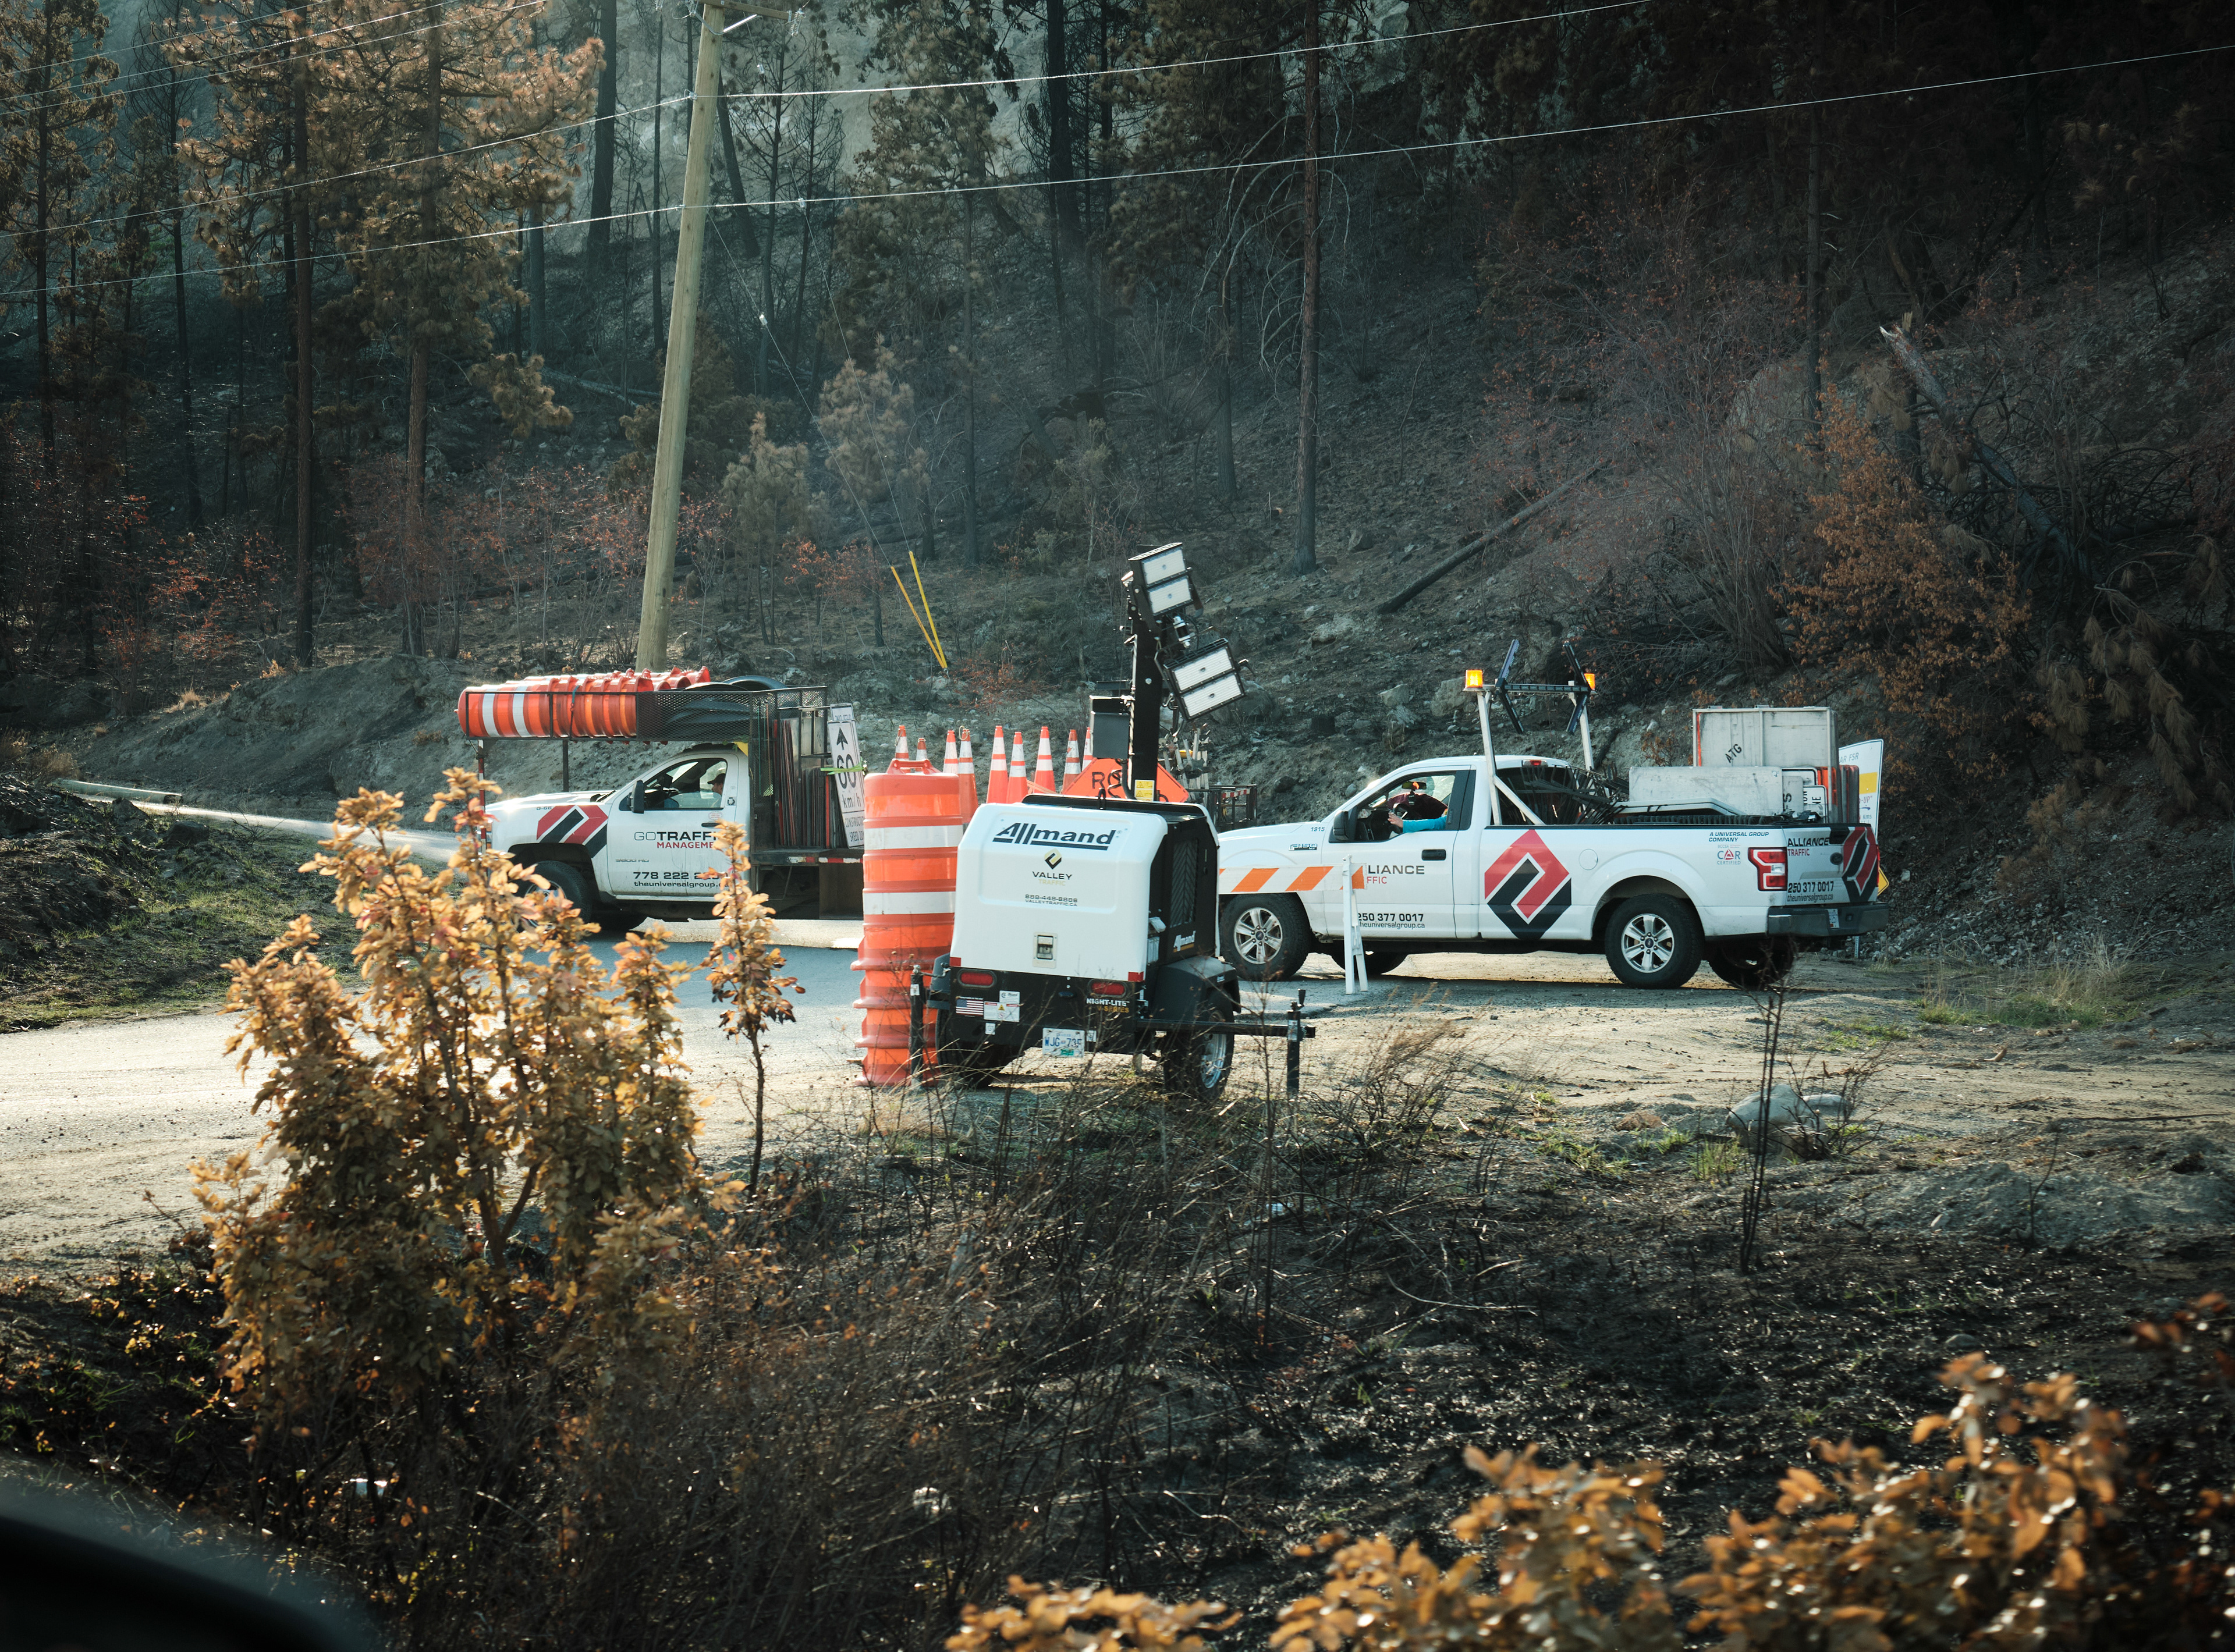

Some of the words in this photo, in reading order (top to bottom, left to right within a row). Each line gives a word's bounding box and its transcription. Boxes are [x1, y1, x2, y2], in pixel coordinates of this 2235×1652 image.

[1725, 744, 1742, 763] ATG
[1849, 752, 1859, 762] FSR
[837, 754, 857, 789] 60
[634, 832, 716, 841] GOTRAFFI
[995, 822, 1116, 845] Allmand
[1788, 837, 1830, 847] ALLIANCE
[1368, 865, 1425, 875] LIANCE
[1032, 871, 1072, 880] VALLEY
[1788, 883, 1801, 893] 250
[1803, 882, 1815, 892] 377
[1817, 881, 1834, 891] 0017
[1358, 913, 1374, 921] 250
[1378, 913, 1395, 921] 377
[1399, 914, 1424, 922] 0017
[1360, 921, 1425, 929] heuniversalgroup.ca
[1086, 998, 1127, 1007] NIGHT-LITE
